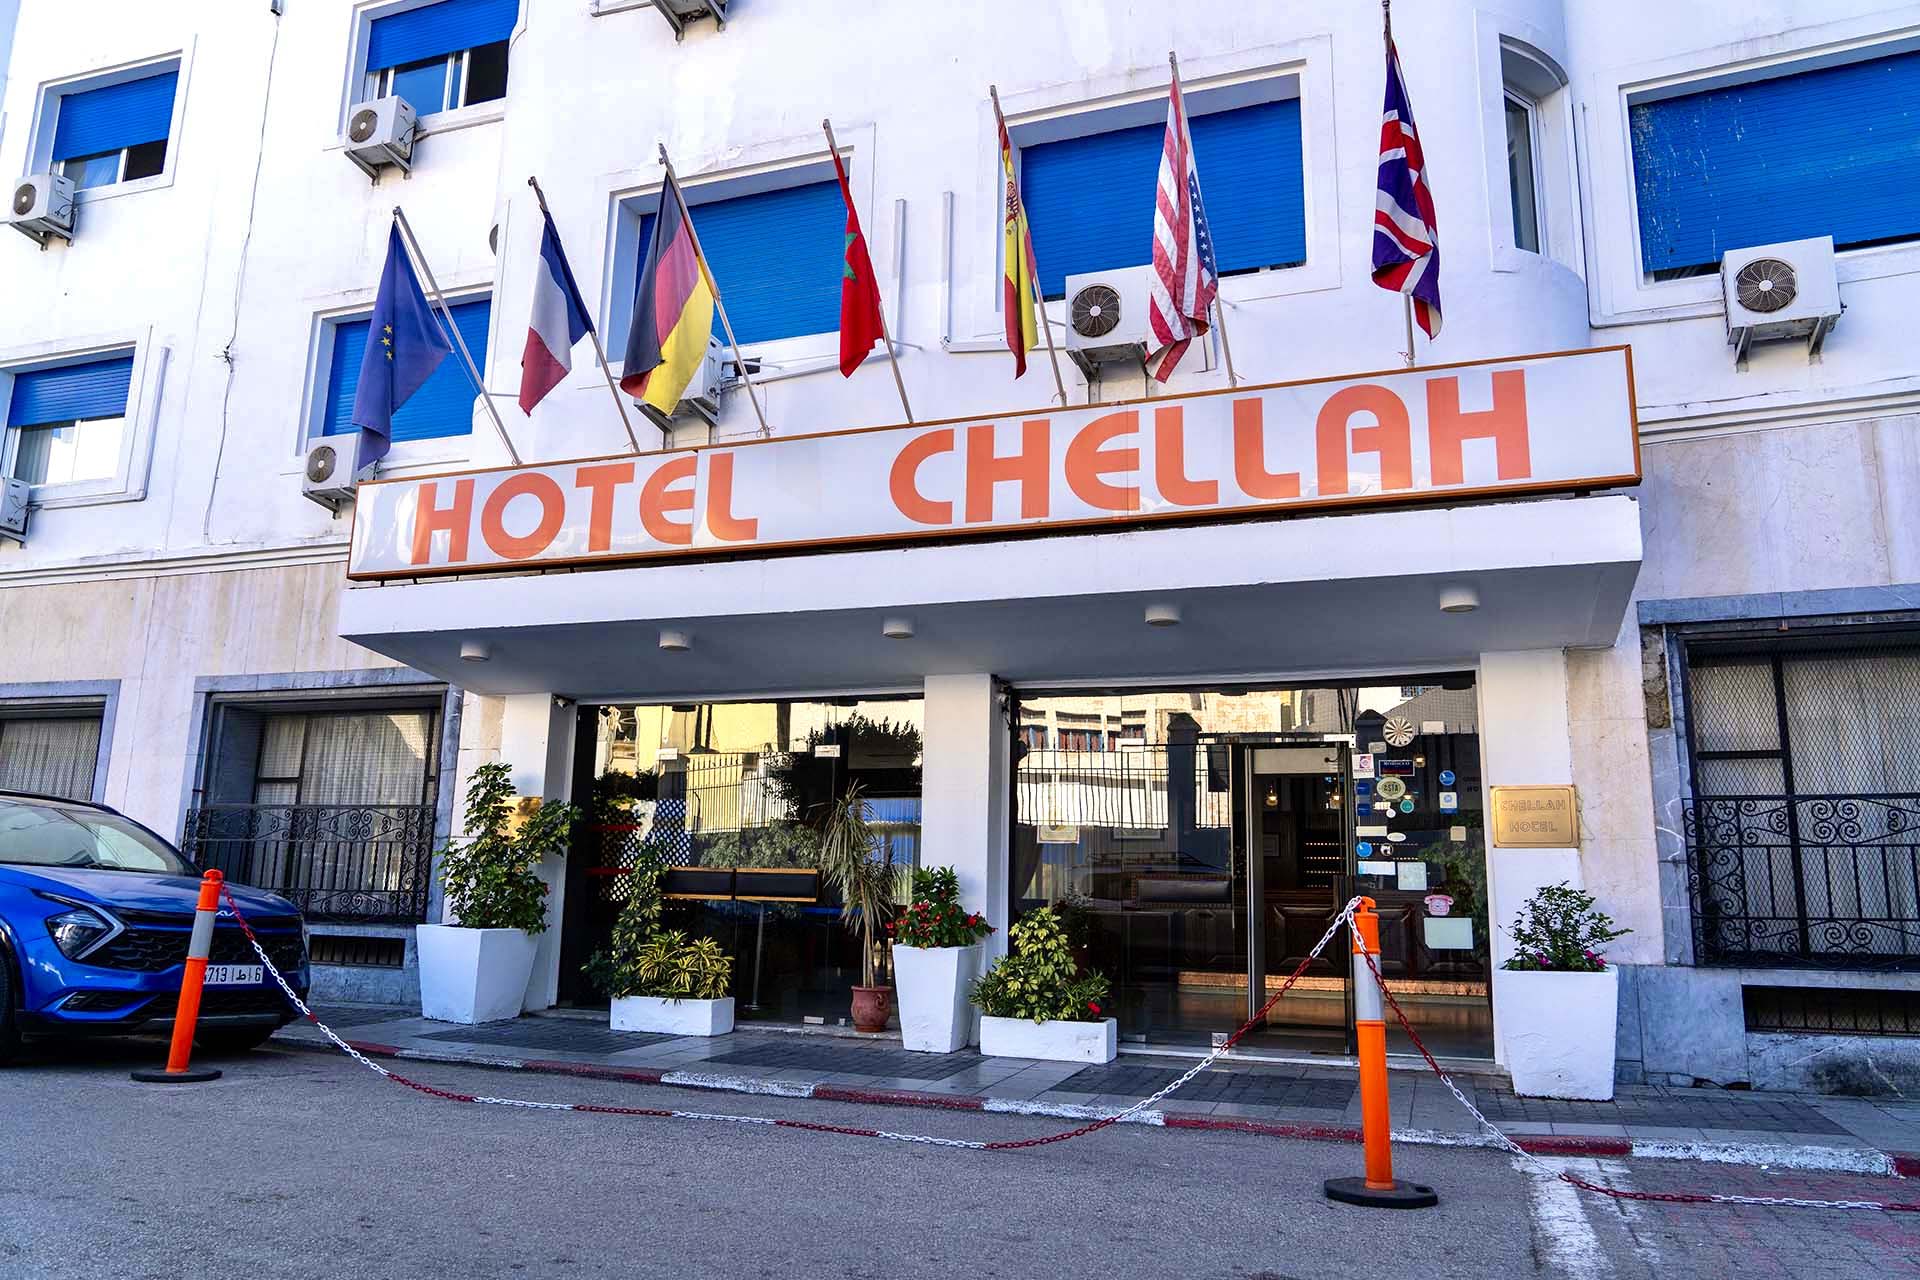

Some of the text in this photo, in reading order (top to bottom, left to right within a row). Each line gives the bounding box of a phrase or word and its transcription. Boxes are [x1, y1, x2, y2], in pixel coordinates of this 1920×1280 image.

[410, 369, 1532, 565] HOTEL CHELLAH
[1501, 799, 1566, 811] CHELLAH
[1509, 821, 1558, 833] HOTEL
